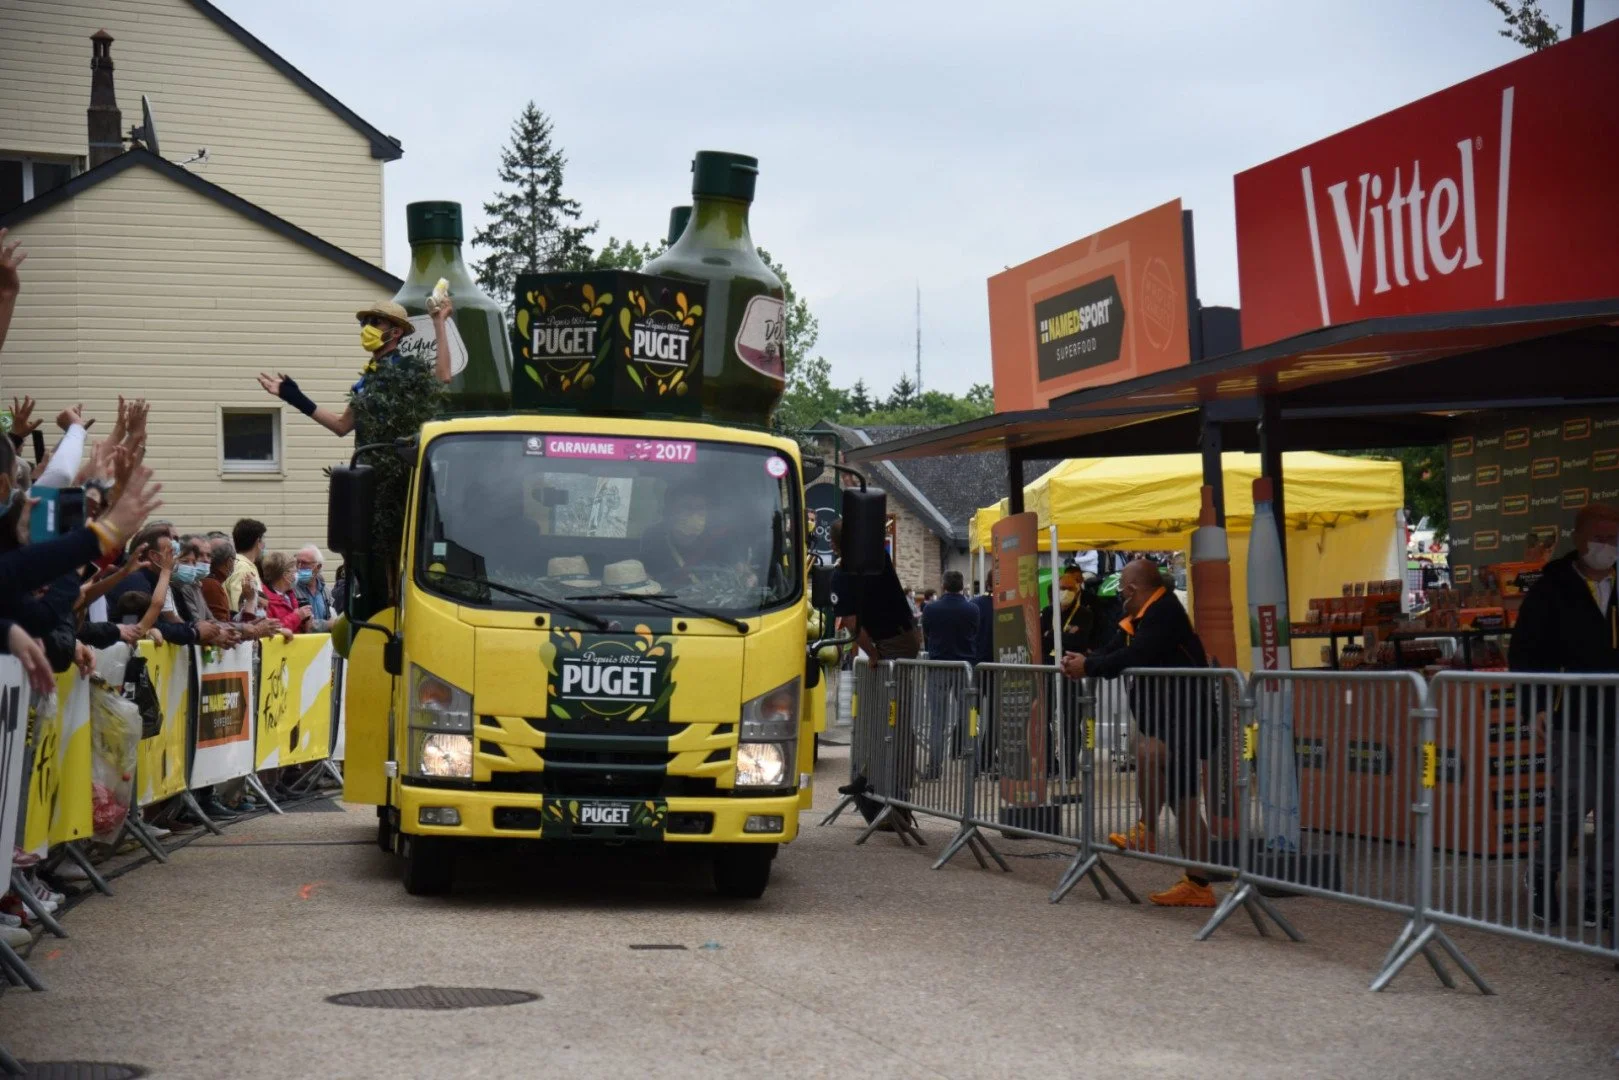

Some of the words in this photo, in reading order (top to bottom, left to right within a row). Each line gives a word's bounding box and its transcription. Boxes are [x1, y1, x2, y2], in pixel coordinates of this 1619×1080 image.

[1327, 137, 1483, 306] Vittel
[532, 327, 597, 354] PUGET
[633, 329, 690, 361] PUGET
[550, 441, 615, 455] CARAVANE
[655, 443, 692, 460] 2017
[582, 651, 617, 665] Depuis
[619, 655, 641, 664] 1857
[562, 665, 657, 695] PUGET
[581, 807, 631, 823] PUGET
